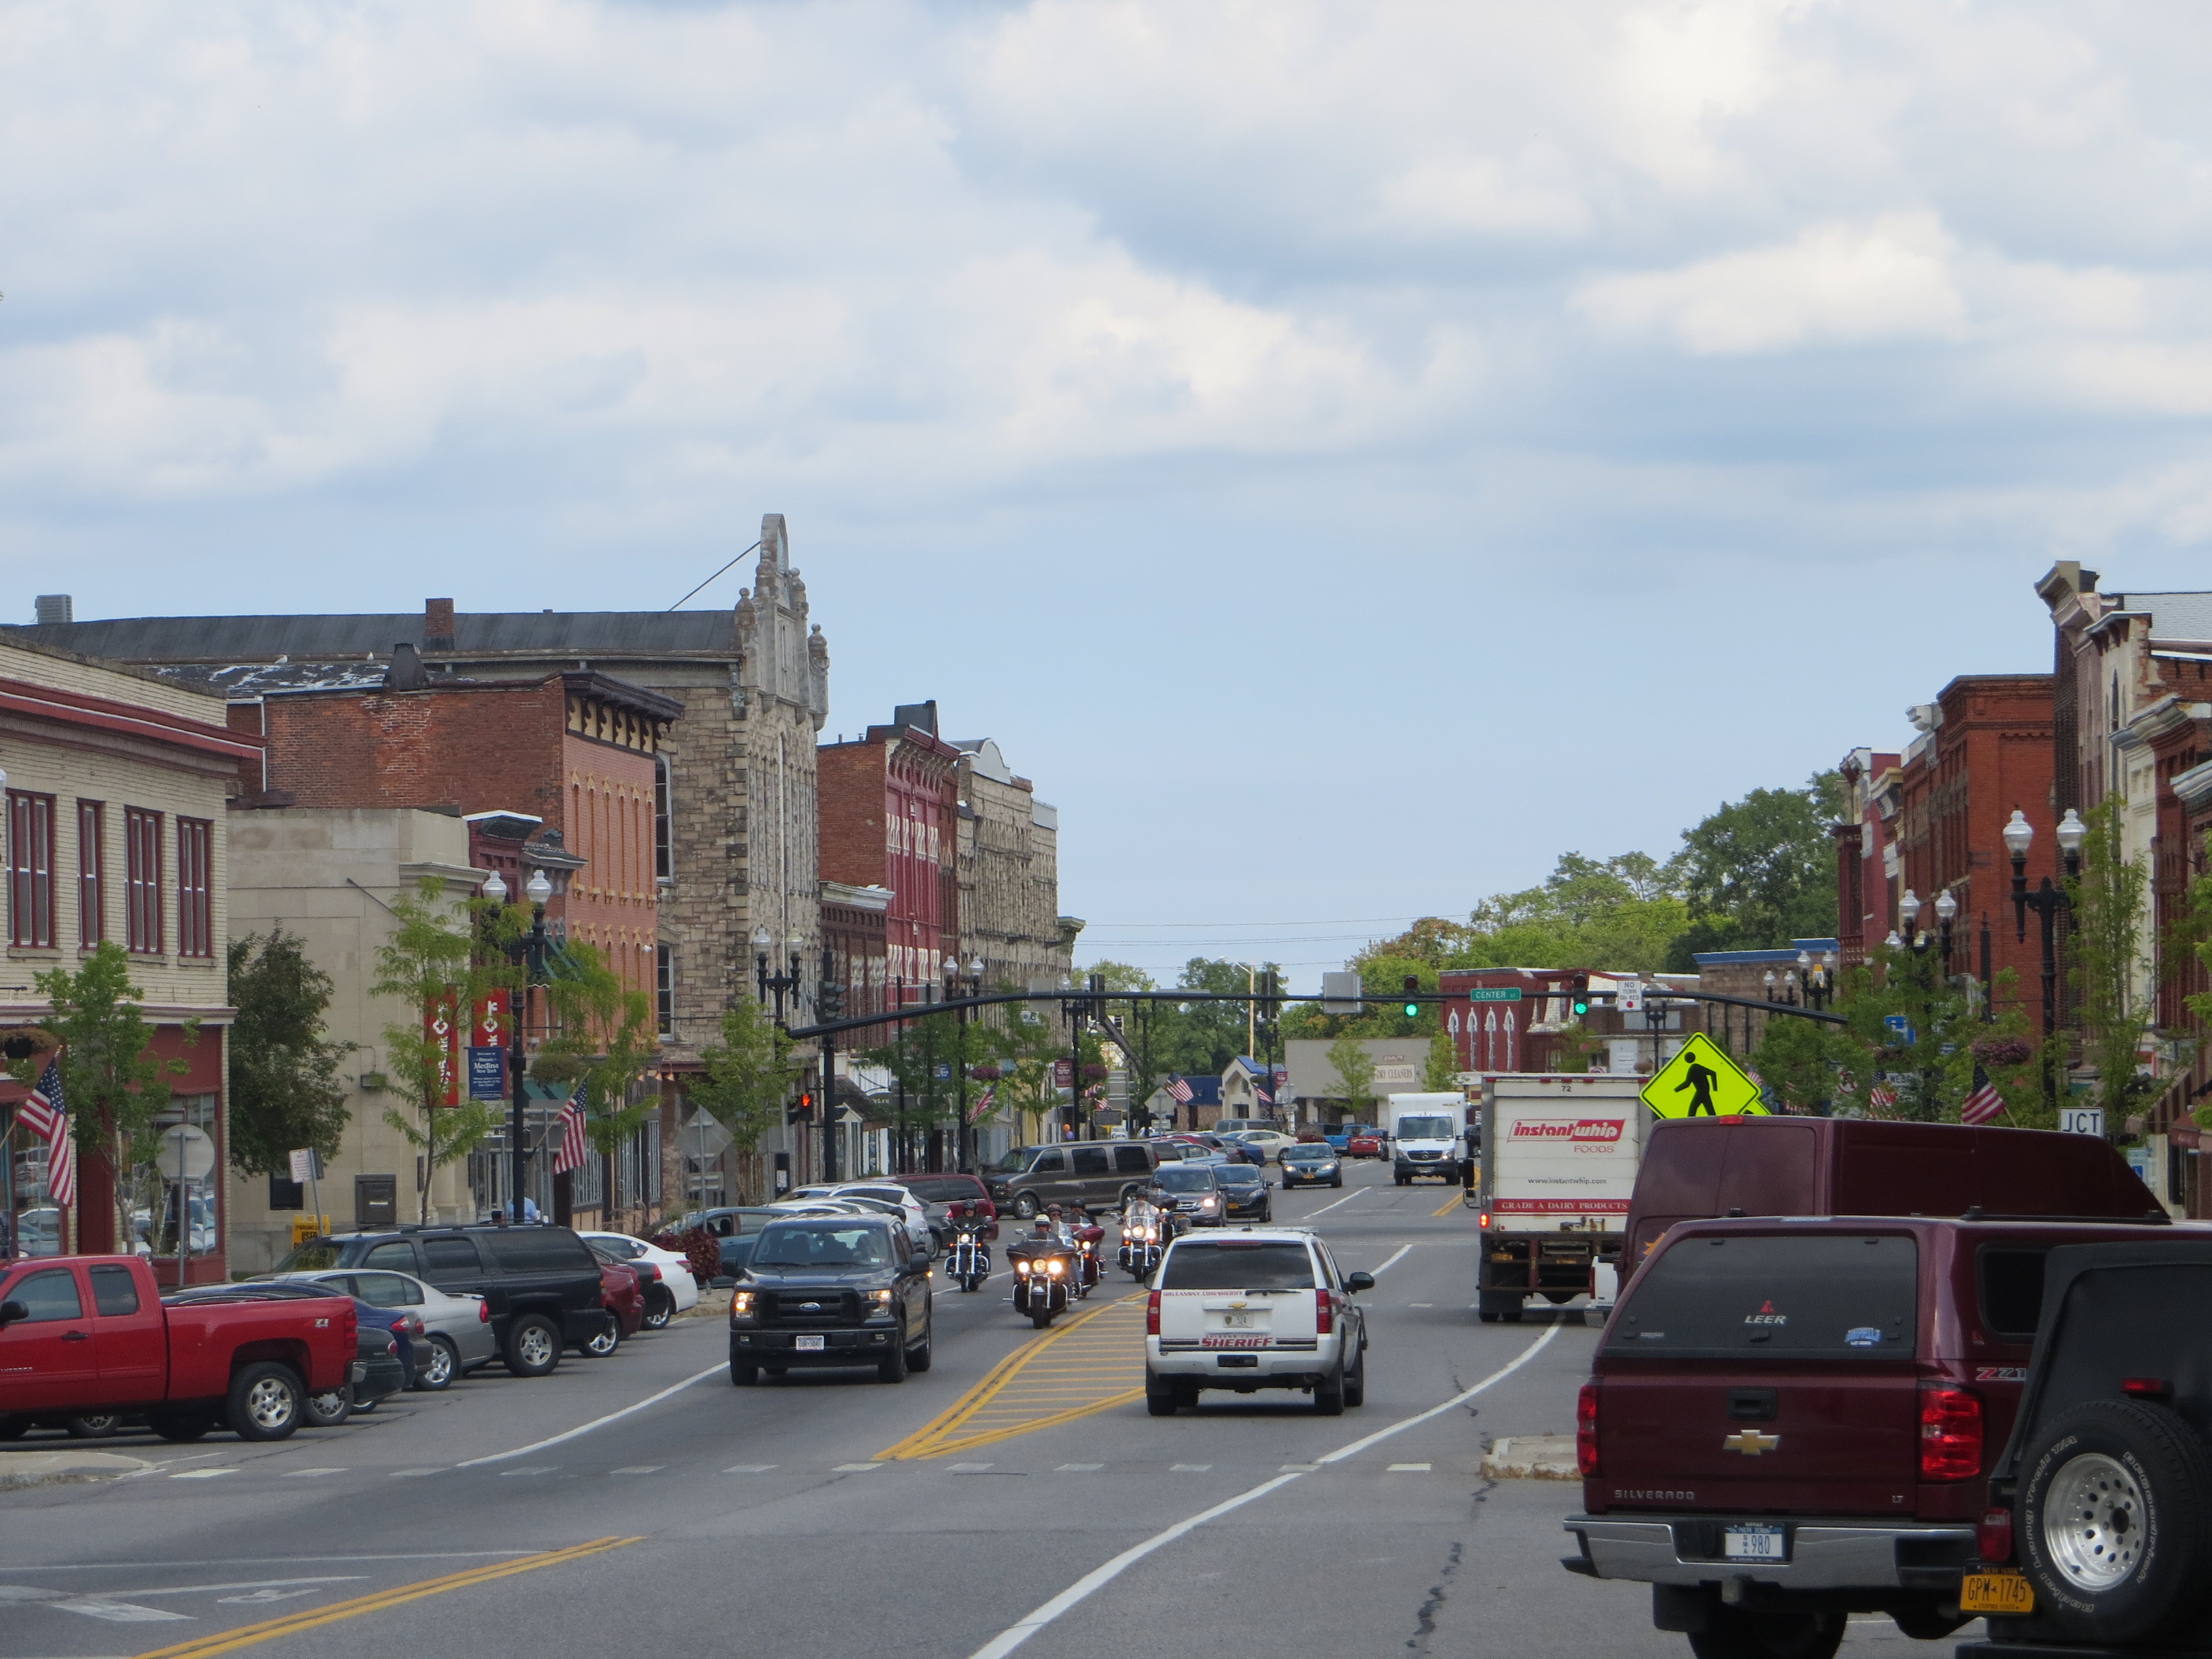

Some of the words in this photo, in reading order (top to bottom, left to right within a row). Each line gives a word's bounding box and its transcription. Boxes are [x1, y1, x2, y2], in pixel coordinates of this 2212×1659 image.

[1388, 1068, 1413, 1079] CLEANERS
[2062, 1112, 2100, 1133] JCT
[1745, 1315, 1786, 1324] LEER
[1201, 1337, 1273, 1346] SHERIFF
[1976, 1367, 2027, 1381] Z71
[1614, 1489, 1695, 1500] SILVERADO
[1892, 1495, 1903, 1503] LT
[1751, 1534, 1771, 1555] 980
